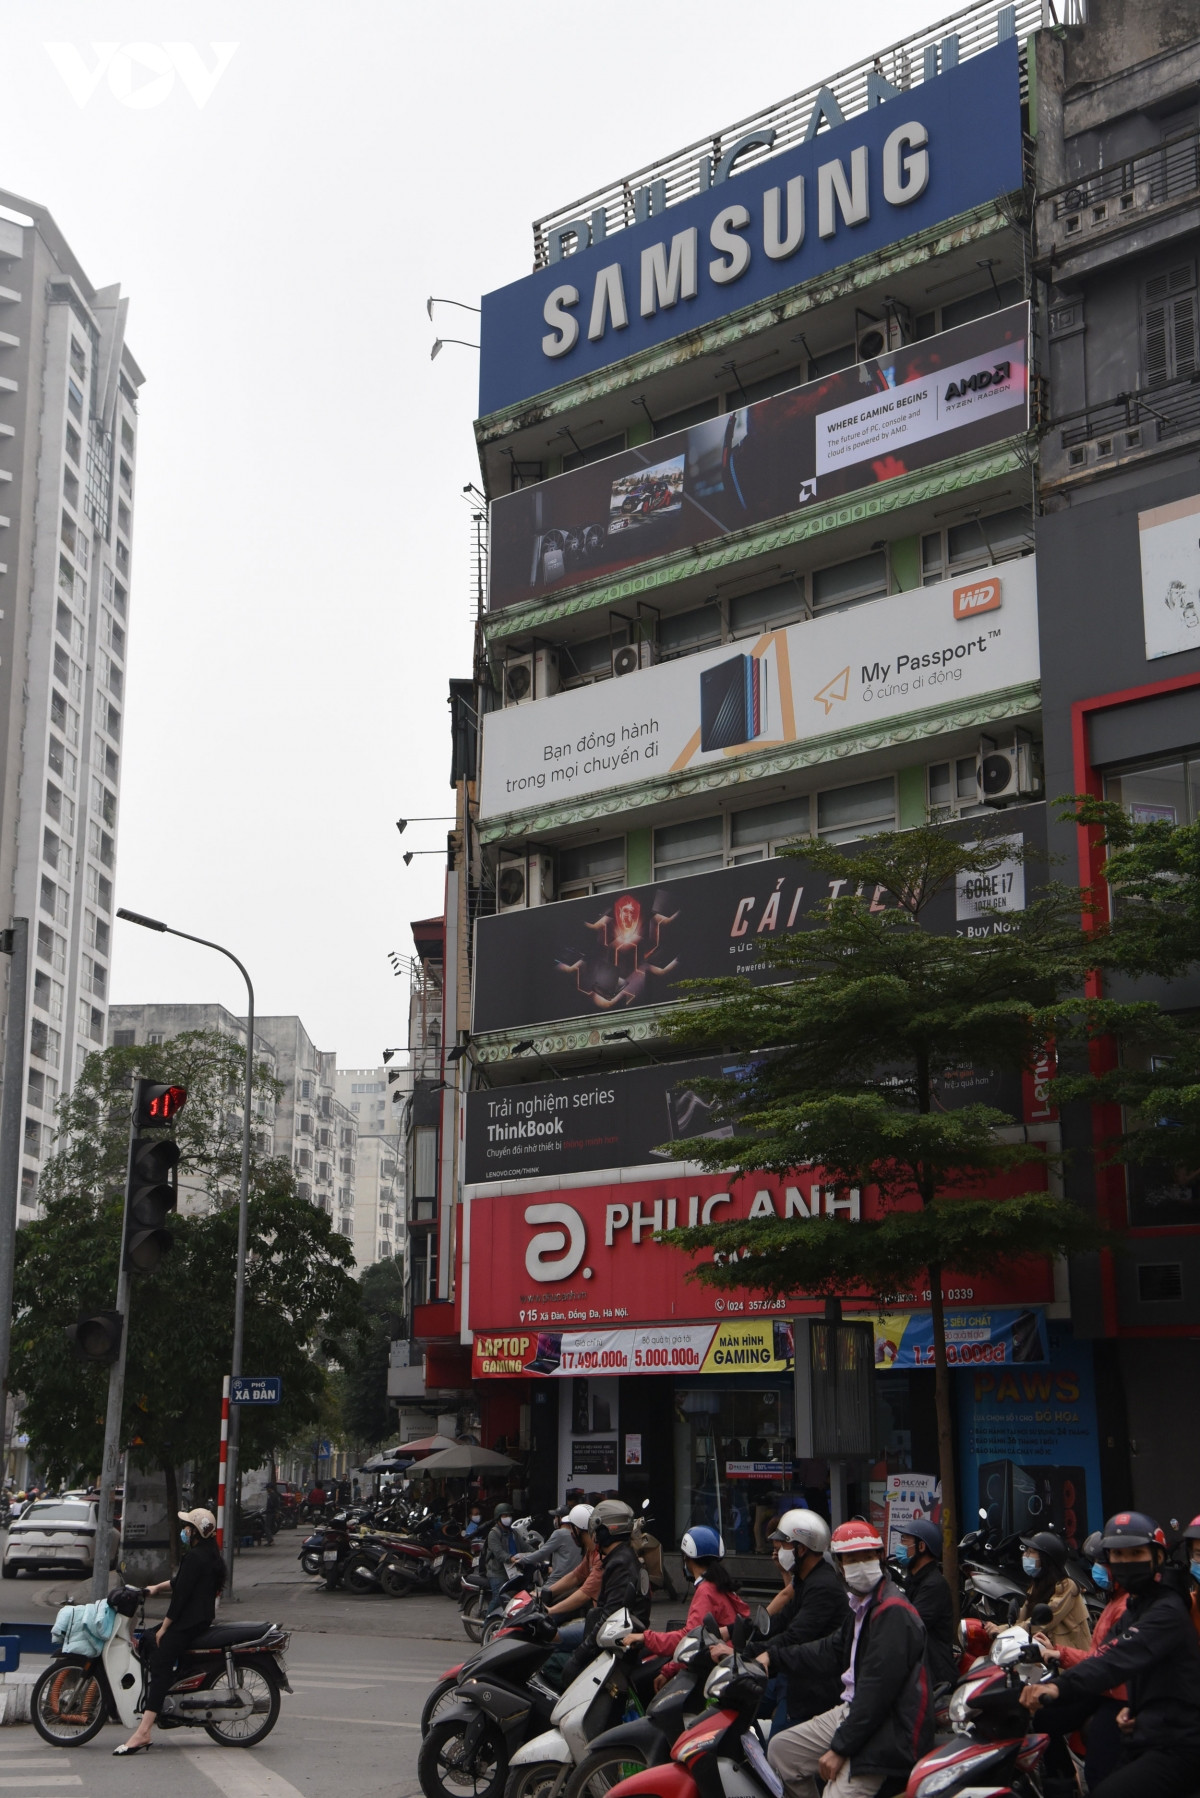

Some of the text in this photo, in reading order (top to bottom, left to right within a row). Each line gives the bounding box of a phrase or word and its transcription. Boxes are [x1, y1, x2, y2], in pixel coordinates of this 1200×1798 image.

[542, 120, 929, 358] SAMSUNG
[945, 365, 1001, 401] AMD
[946, 384, 1011, 411] RYZEN RADEON
[827, 390, 928, 433] WHERE GAMING BEGINS
[827, 437, 840, 448] The
[840, 429, 860, 444] future
[861, 426, 869, 437] of
[882, 414, 907, 430] console
[908, 408, 921, 421] and
[827, 445, 845, 458] cloud
[845, 443, 852, 452] is
[852, 433, 880, 452] powered
[881, 429, 889, 442] by
[959, 585, 995, 611] WD
[861, 662, 891, 683] My
[877, 680, 909, 699] cứng
[912, 675, 924, 689] di
[928, 668, 962, 685] động
[543, 718, 659, 762] Bạn đồng hành
[506, 740, 659, 793] trong mọi chuyến đi
[966, 872, 1014, 900] CORE i7
[993, 897, 1007, 909] GEN
[967, 925, 990, 938] Buy
[736, 960, 766, 974] Powered
[487, 1087, 615, 1118] Trải nghiệm series
[487, 1116, 564, 1142] ThinkBook
[555, 1140, 562, 1151] bị
[485, 1167, 540, 1179] LENOVO.COM/THINK
[748, 1184, 861, 1222] ANH
[948, 1288, 974, 1300] 0339
[527, 1309, 538, 1321] 15
[540, 1311, 549, 1321] Xã
[603, 1308, 613, 1318] Hà
[476, 1337, 530, 1357] LAPTOP
[574, 1339, 586, 1348] Giá
[651, 1335, 665, 1345] quà
[671, 1334, 681, 1345] giá
[719, 1331, 764, 1347] MÀN HÌNH
[561, 1350, 628, 1369] 17.490.000đ
[634, 1347, 699, 1368] 5.000.000đ
[713, 1348, 771, 1364] GAMING
[482, 1360, 522, 1373] GAMING
[235, 1387, 276, 1400] XÃ ĐÀN
[251, 1380, 267, 1388] PHỐ
[973, 1370, 1080, 1403] PAWS
[1020, 1414, 1033, 1422] CHO
[892, 1511, 901, 1519] TRẢ
